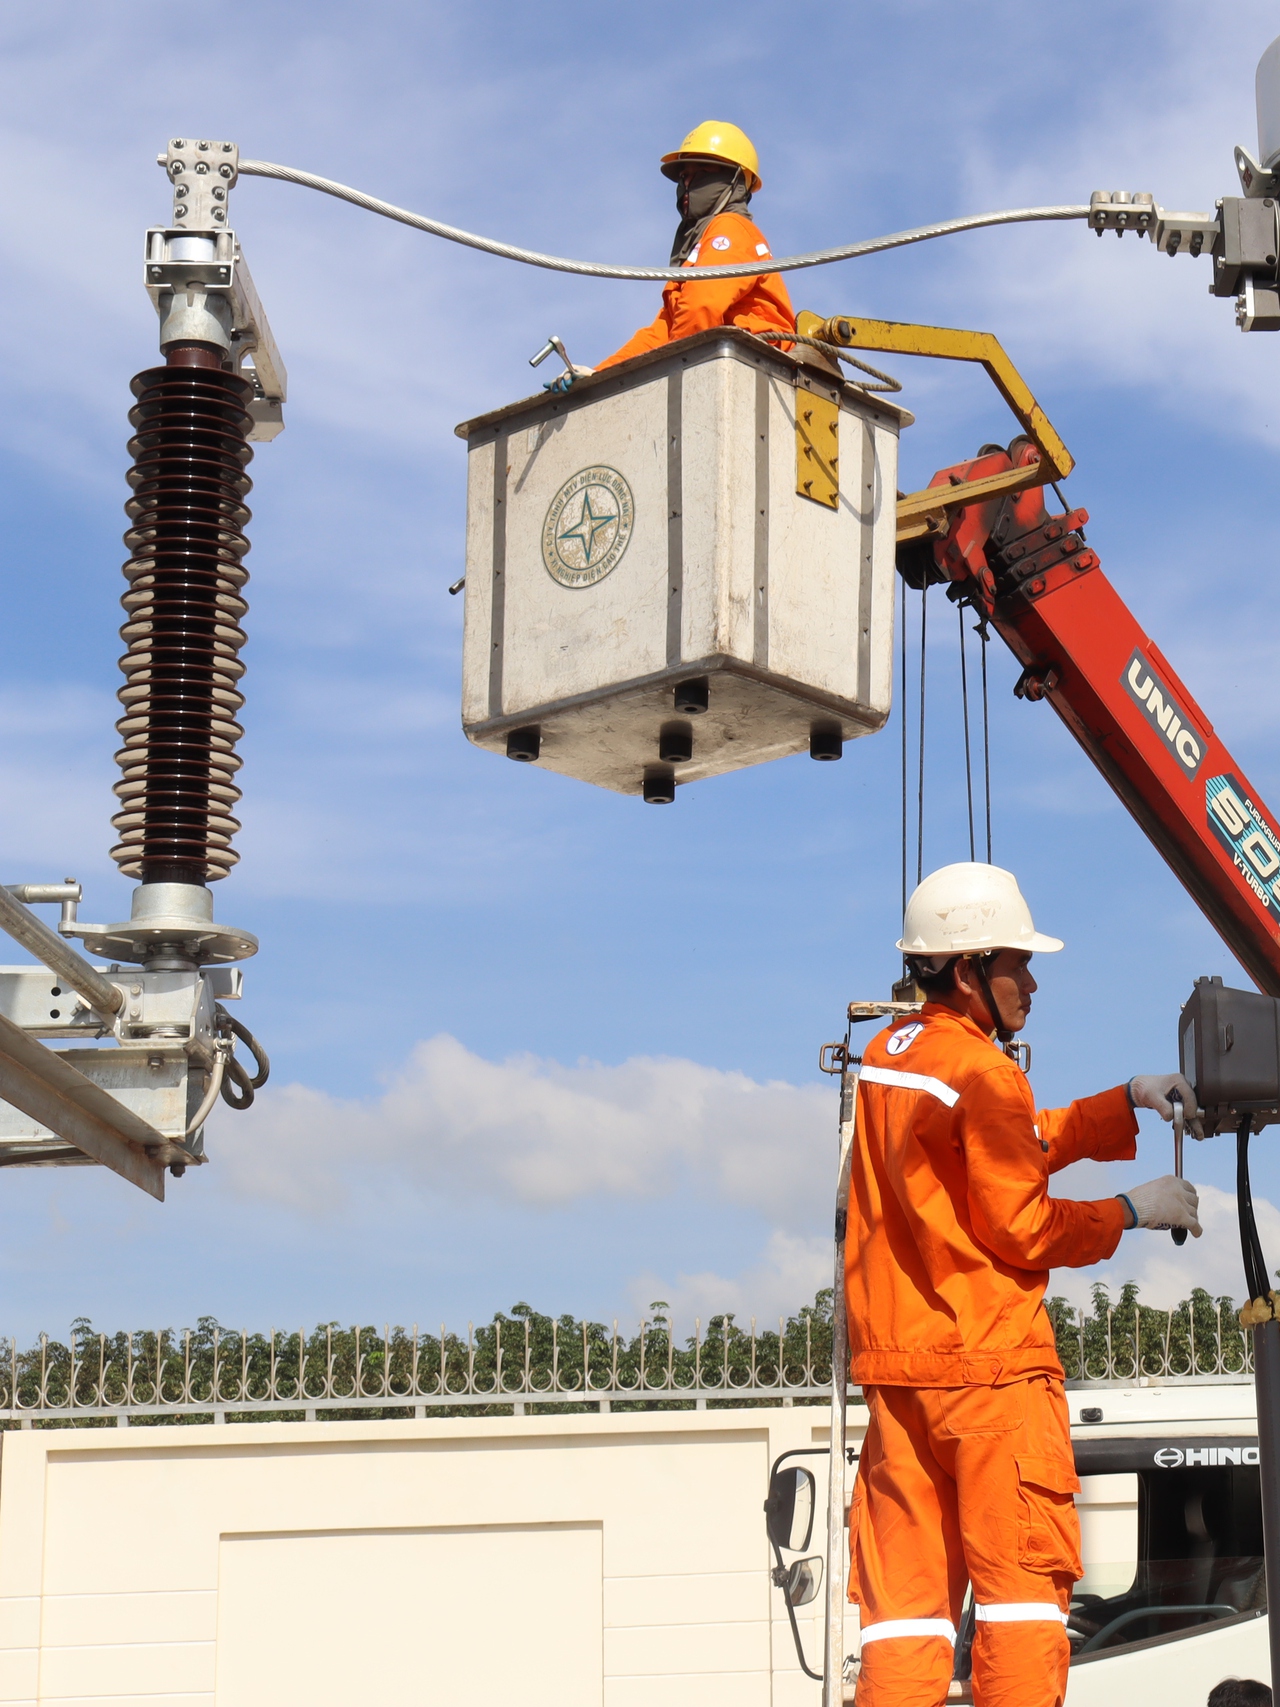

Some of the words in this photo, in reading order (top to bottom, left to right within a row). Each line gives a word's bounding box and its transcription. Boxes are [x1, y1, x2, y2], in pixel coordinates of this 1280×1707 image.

[563, 482, 577, 497] MTV
[1128, 658, 1200, 768] UNIC
[1244, 799, 1280, 852] FURUKAWA
[1233, 852, 1270, 907] V-TURBO
[1185, 1447, 1260, 1467] HINO
